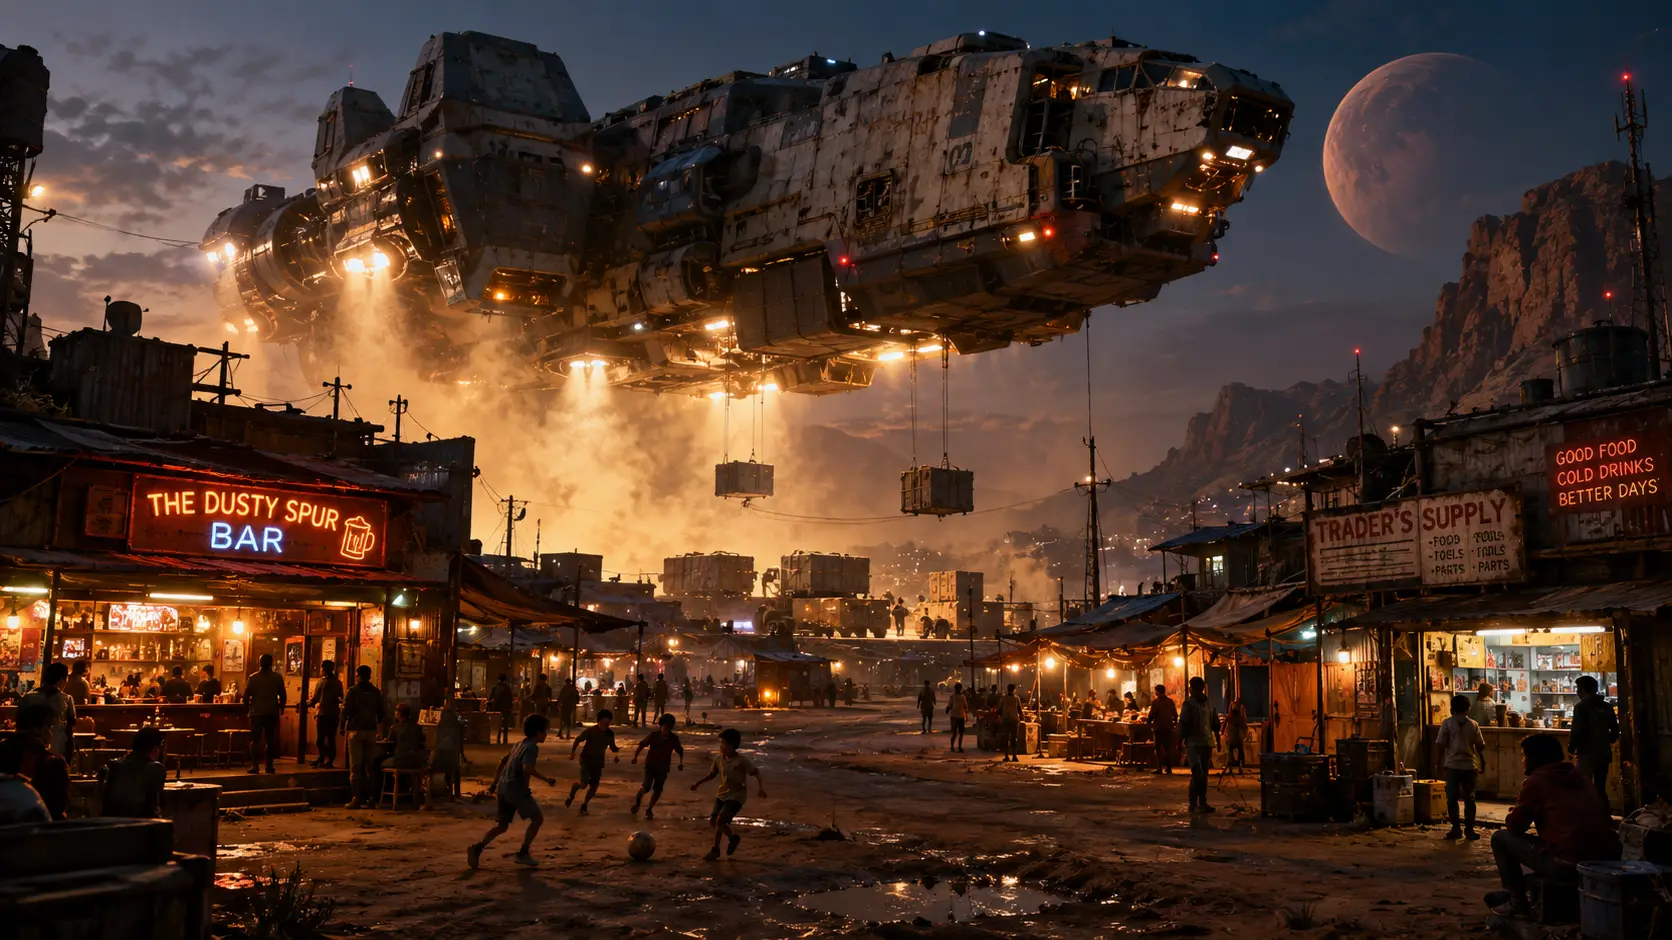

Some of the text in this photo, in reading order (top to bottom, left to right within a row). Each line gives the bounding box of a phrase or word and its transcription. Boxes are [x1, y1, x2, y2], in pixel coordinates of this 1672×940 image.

[1556, 439, 1637, 466] GOOD FOOD
[1557, 457, 1655, 486] COLD DRINKS
[1559, 478, 1658, 507] BETTER DAYS
[147, 491, 340, 532] THE DUSTY SPUR
[1315, 498, 1506, 544] TRADER'S SUPPLY
[210, 521, 283, 553] BAR
[1434, 563, 1466, 577] PARTS
[1478, 559, 1510, 573] PARTS
